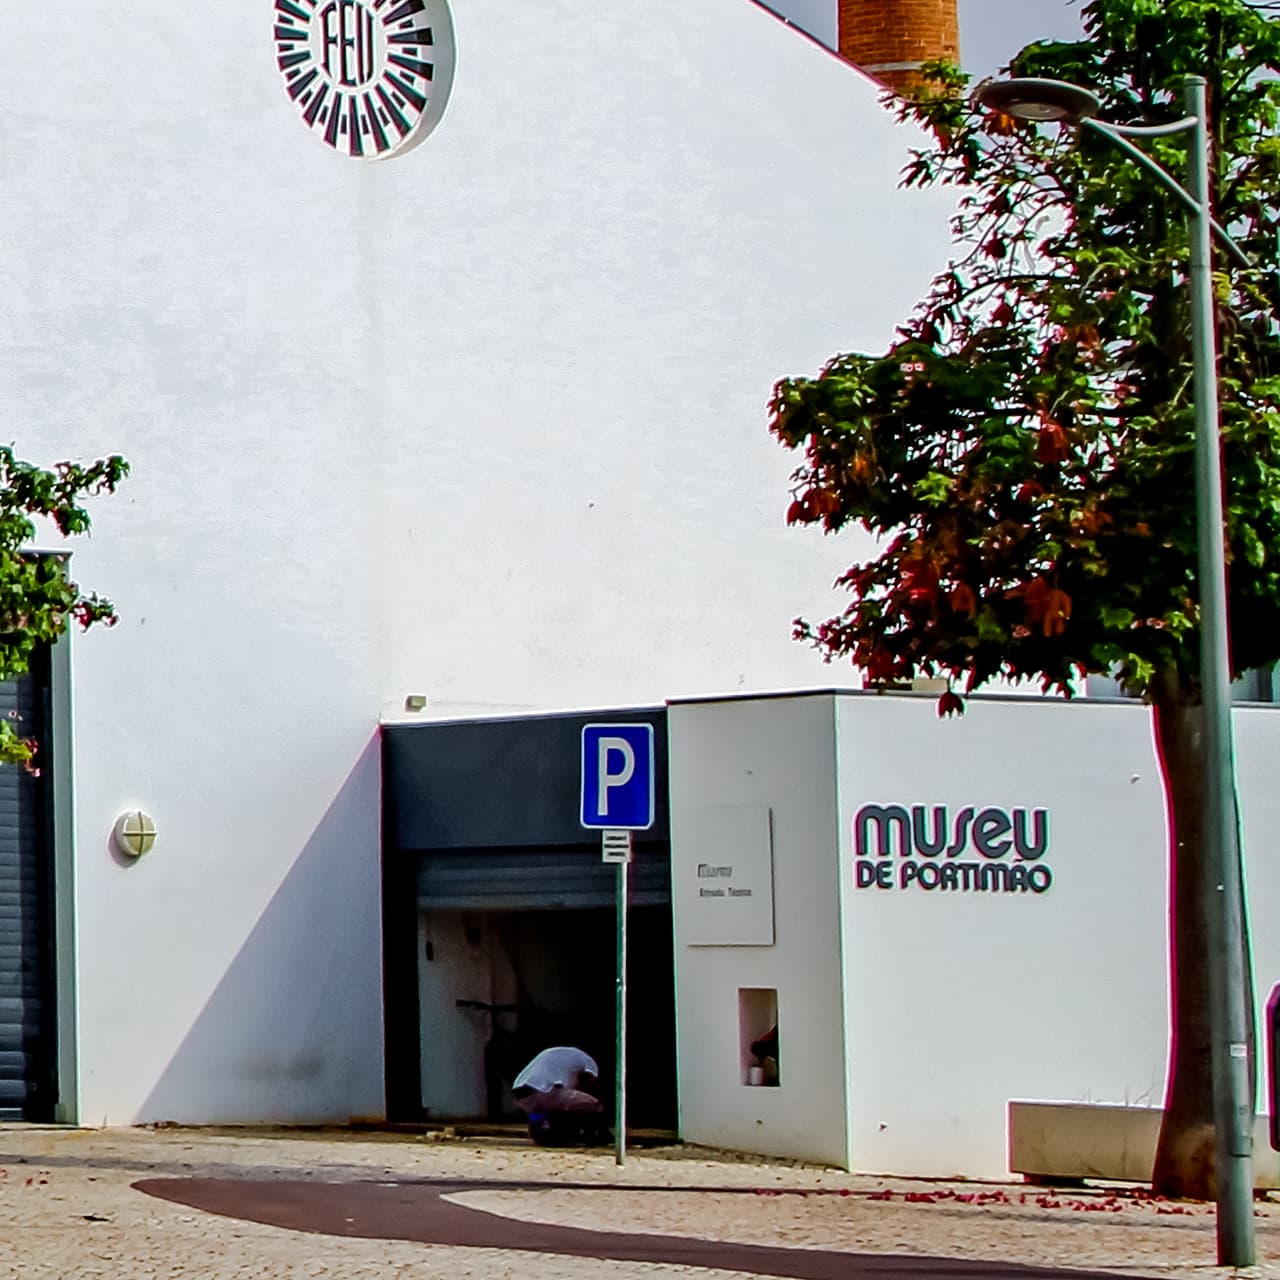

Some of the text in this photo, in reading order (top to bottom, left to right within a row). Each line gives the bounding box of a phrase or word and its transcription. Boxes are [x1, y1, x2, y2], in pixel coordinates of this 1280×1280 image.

[597, 736, 635, 816] P
[855, 858, 1053, 894] DE PORTIMÃO
